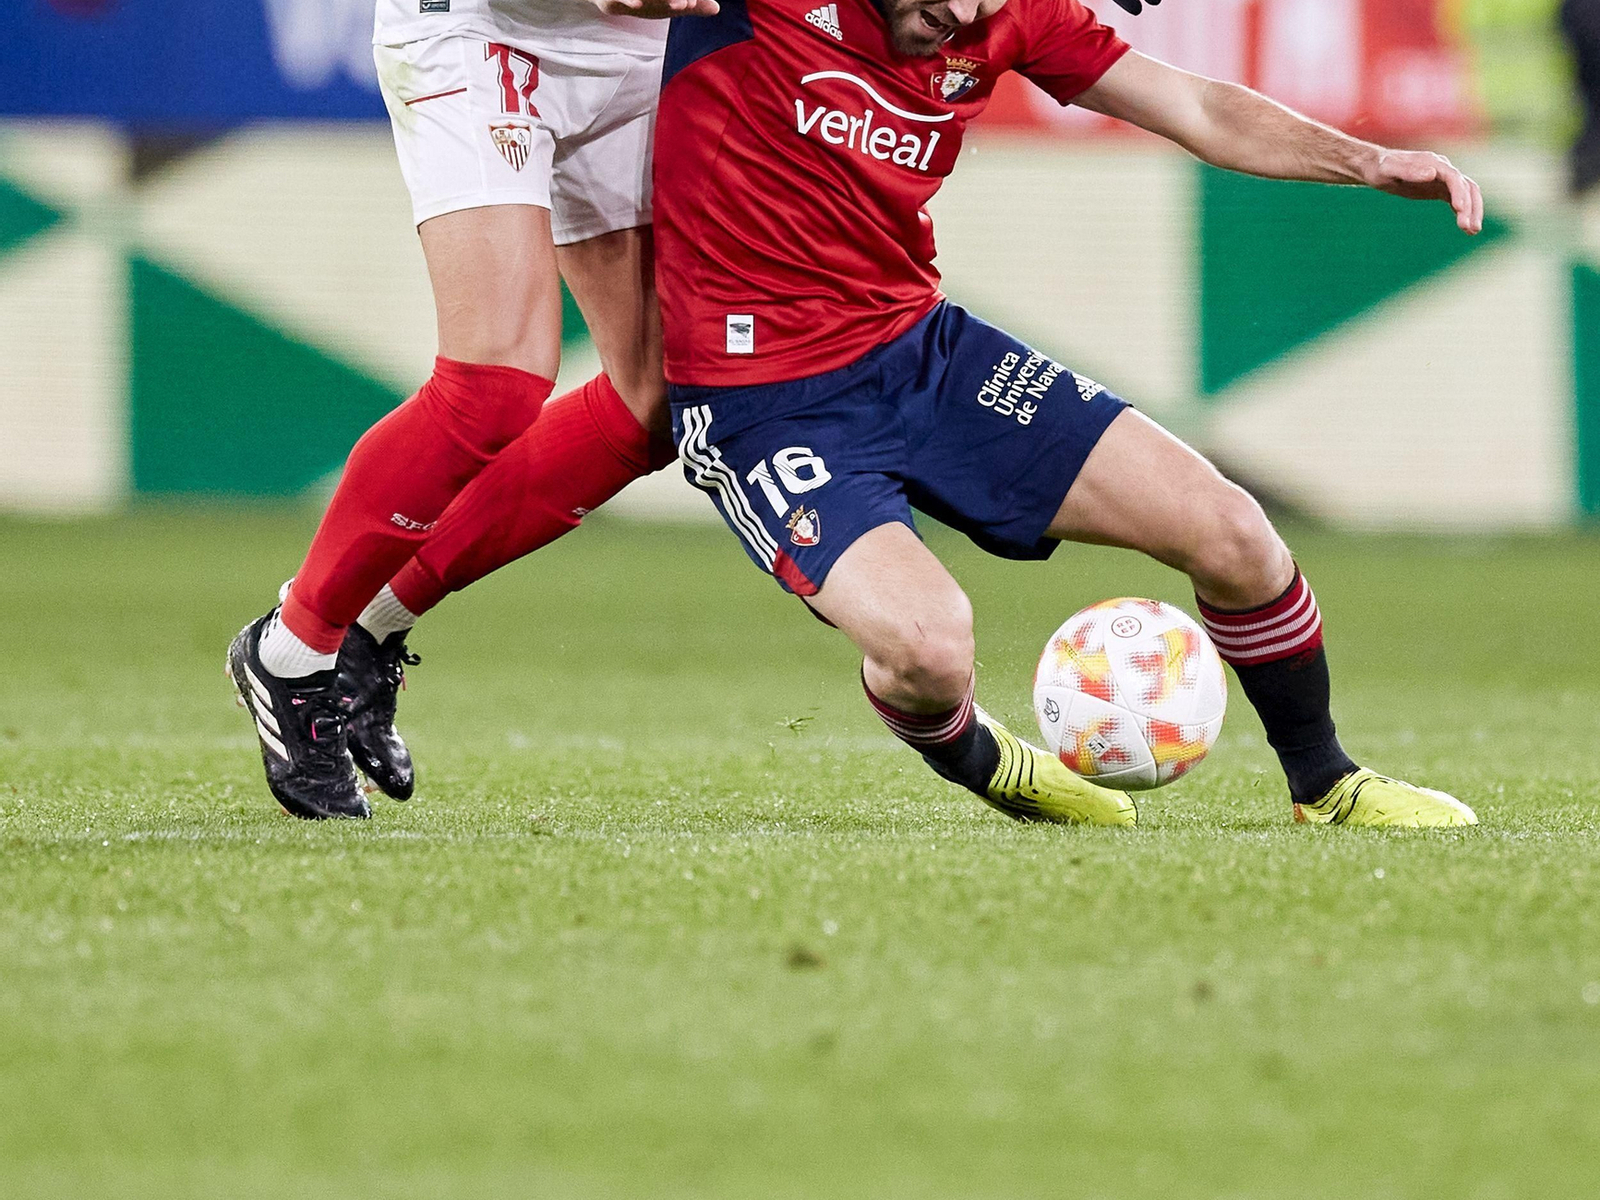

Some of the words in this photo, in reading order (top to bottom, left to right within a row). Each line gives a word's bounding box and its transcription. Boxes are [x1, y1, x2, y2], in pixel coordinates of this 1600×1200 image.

[804, 12, 843, 41] adidas
[483, 41, 542, 121] 17
[794, 98, 941, 172] verleal
[977, 351, 1021, 407] Clínica
[1014, 400, 1038, 426] de
[746, 446, 832, 519] 16
